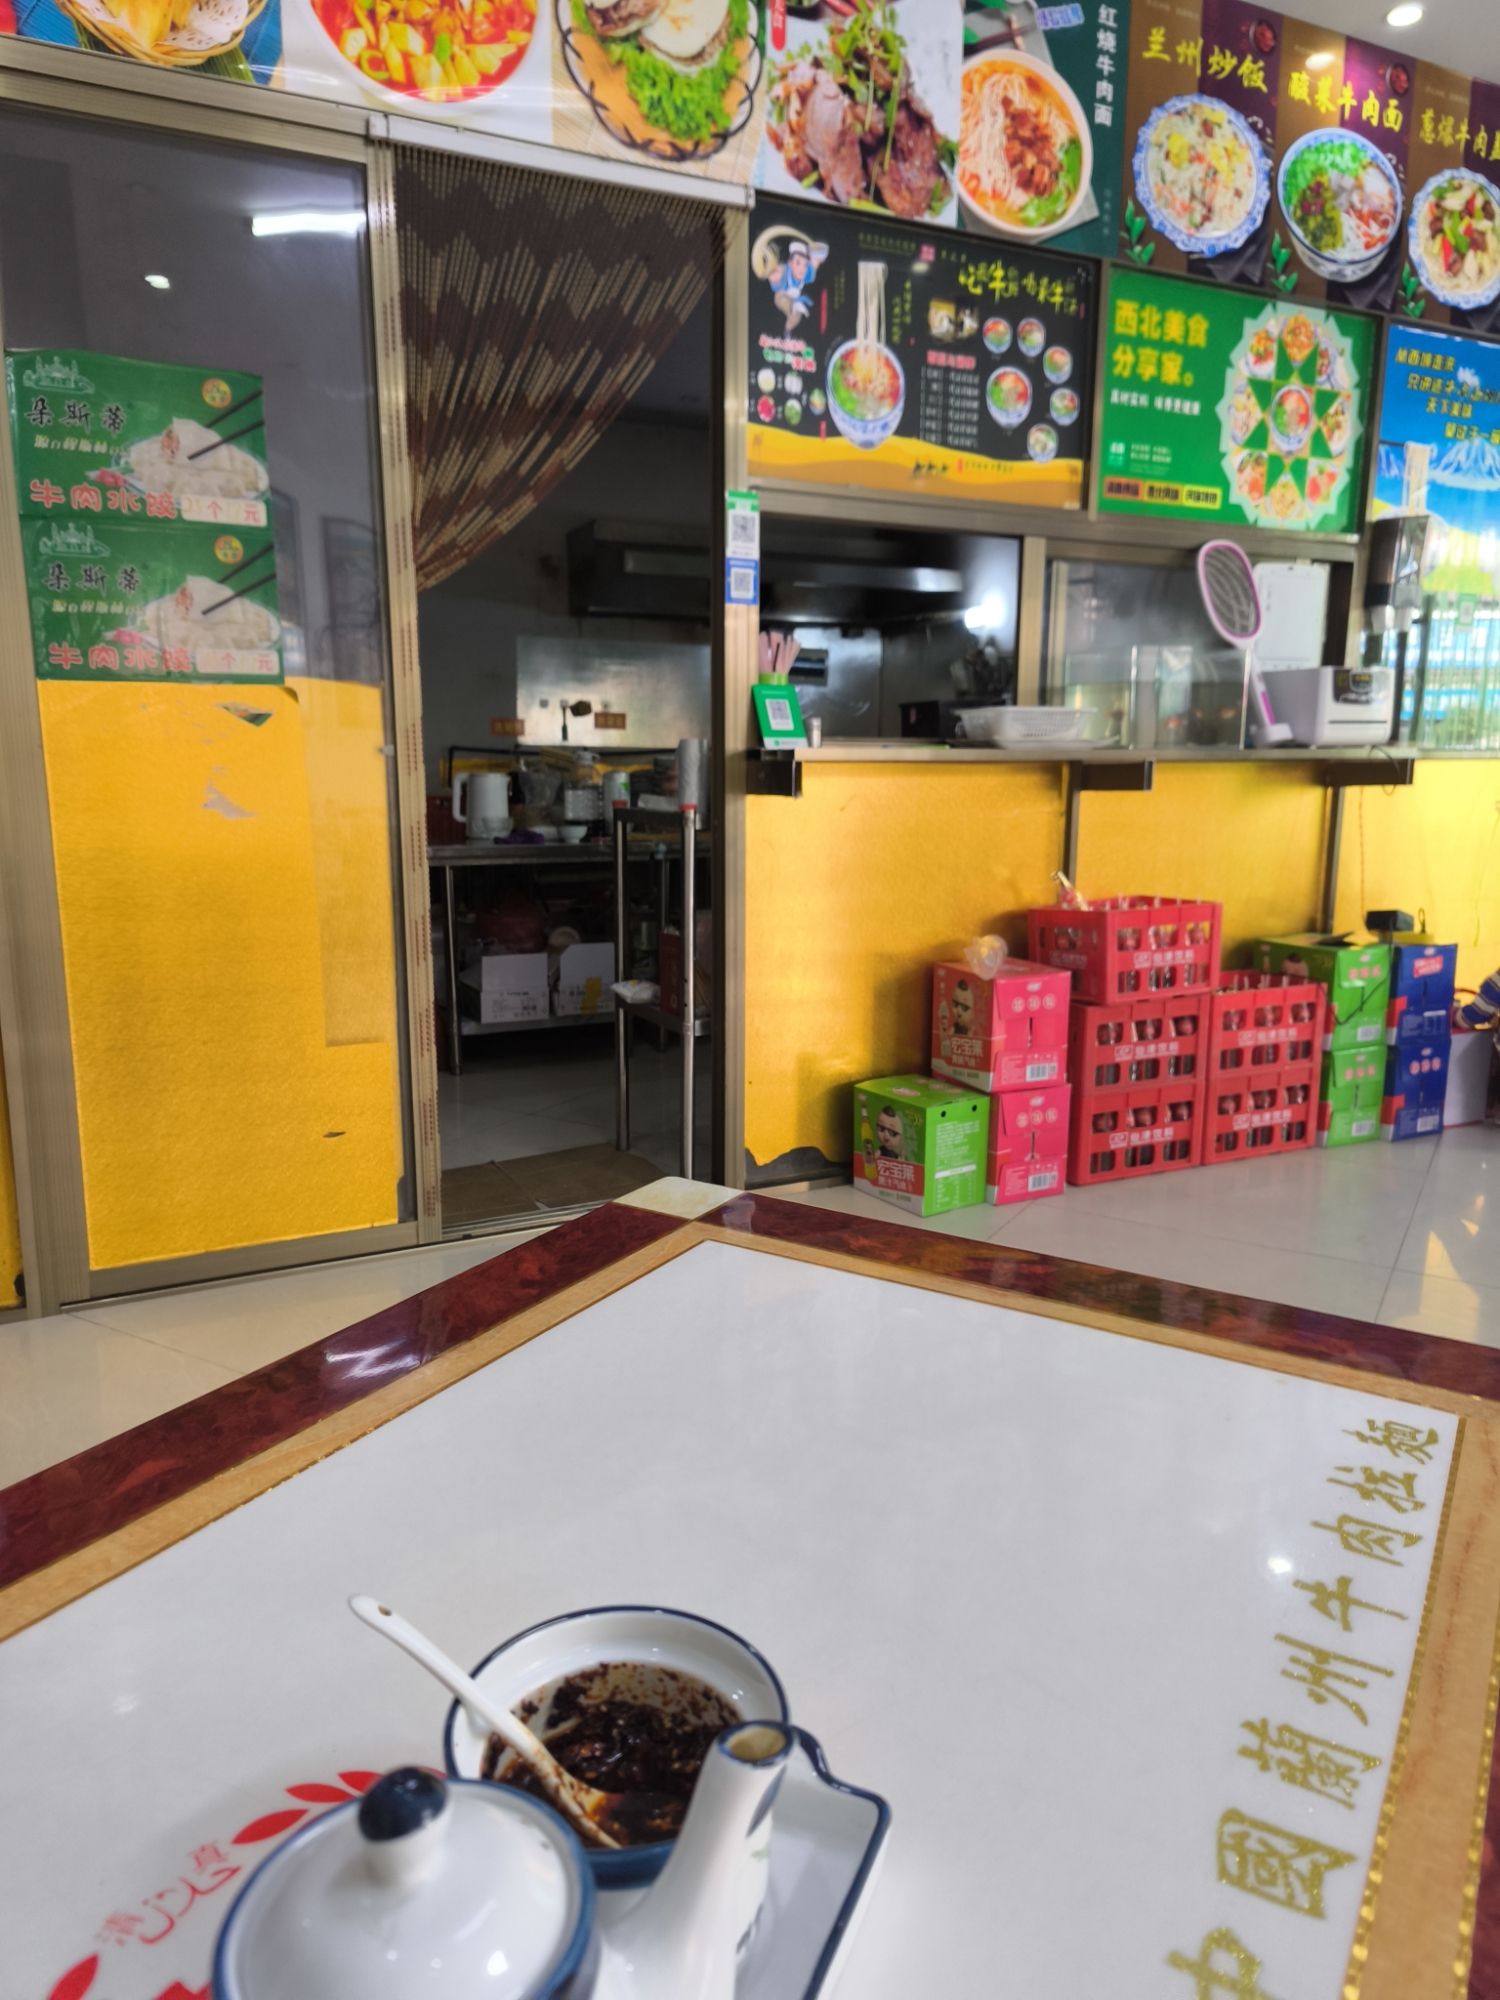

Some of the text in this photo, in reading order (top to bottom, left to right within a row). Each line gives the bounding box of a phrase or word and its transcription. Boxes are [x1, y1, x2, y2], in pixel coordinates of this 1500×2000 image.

[1094, 3, 1118, 127] 红烧牛肉面
[1142, 26, 1268, 94] 兰州炒饭
[1114, 299, 1209, 349] 西北美食
[30, 478, 177, 519] 牛肉水饺
[48, 643, 194, 673] 牛肉水饺
